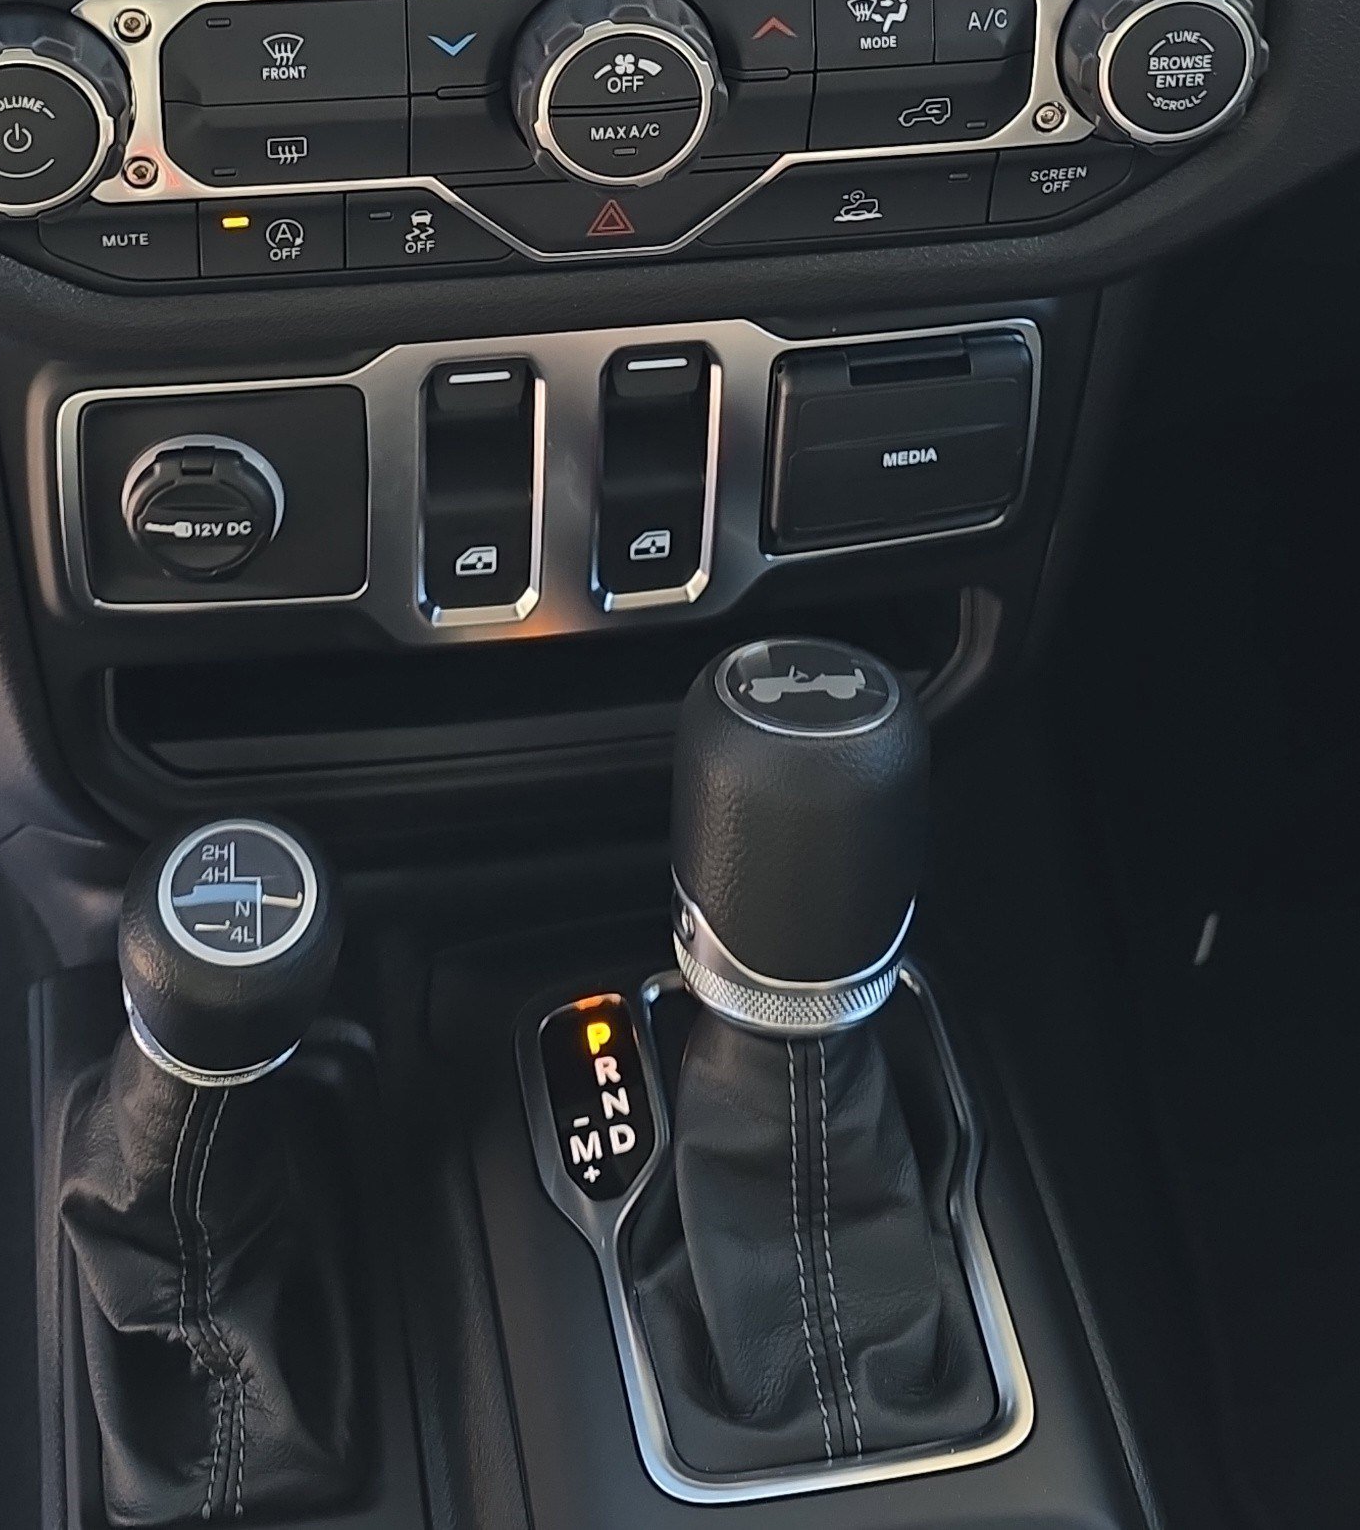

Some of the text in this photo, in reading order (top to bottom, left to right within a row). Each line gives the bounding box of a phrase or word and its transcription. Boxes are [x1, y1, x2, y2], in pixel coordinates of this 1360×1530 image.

[967, 8, 1008, 31] A/C
[859, 34, 898, 50] MODE
[1165, 30, 1202, 45] TUNE
[1149, 54, 1213, 71] BROWSE
[261, 66, 308, 81] FRONT
[1155, 73, 1205, 89] ENTER
[606, 75, 645, 94] OFF
[1152, 95, 1202, 111] SCROLL
[590, 123, 661, 141] MAX A/C
[1029, 165, 1088, 183] SCREEN
[1041, 179, 1071, 194] OFF
[101, 232, 150, 249] MUTE
[404, 239, 437, 254] OFF
[268, 246, 302, 261] OFF
[882, 447, 938, 468] MEDIA
[194, 520, 252, 537] 12V DC
[201, 843, 229, 862] 2H
[200, 866, 229, 883] 4H
[234, 900, 251, 918] N
[229, 925, 255, 944] 4L
[586, 1022, 612, 1056] P
[594, 1056, 622, 1087] R
[601, 1086, 630, 1120] N
[569, 1130, 604, 1166] M
[608, 1123, 636, 1156] D
